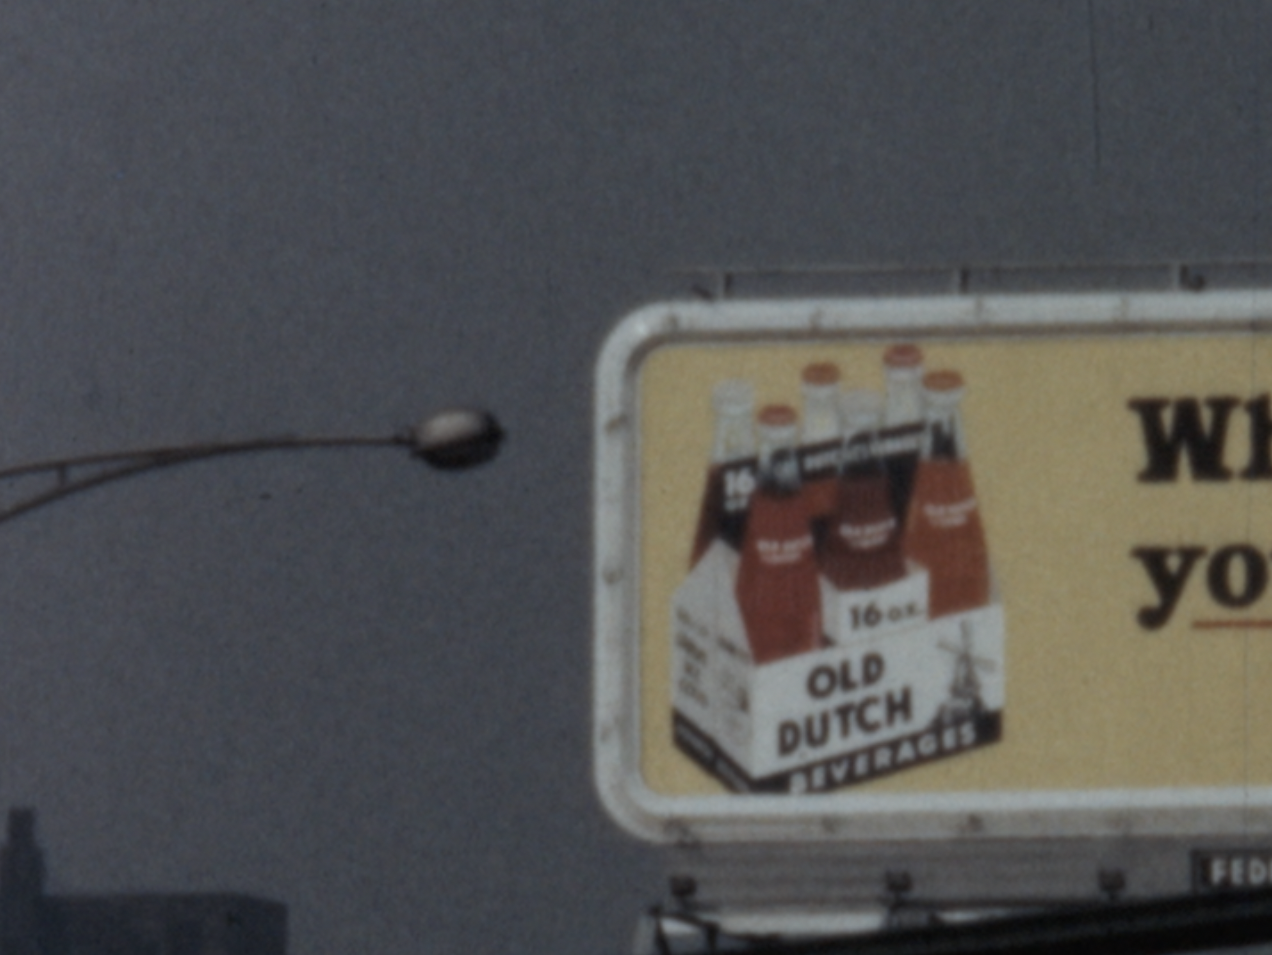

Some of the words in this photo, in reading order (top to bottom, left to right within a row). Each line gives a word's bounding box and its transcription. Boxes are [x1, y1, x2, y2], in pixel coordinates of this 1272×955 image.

[725, 466, 757, 498] 16
[849, 602, 882, 631] 16
[807, 652, 884, 700] OLD
[779, 685, 912, 757] DUTCH
[788, 721, 977, 796] BEVERAGES
